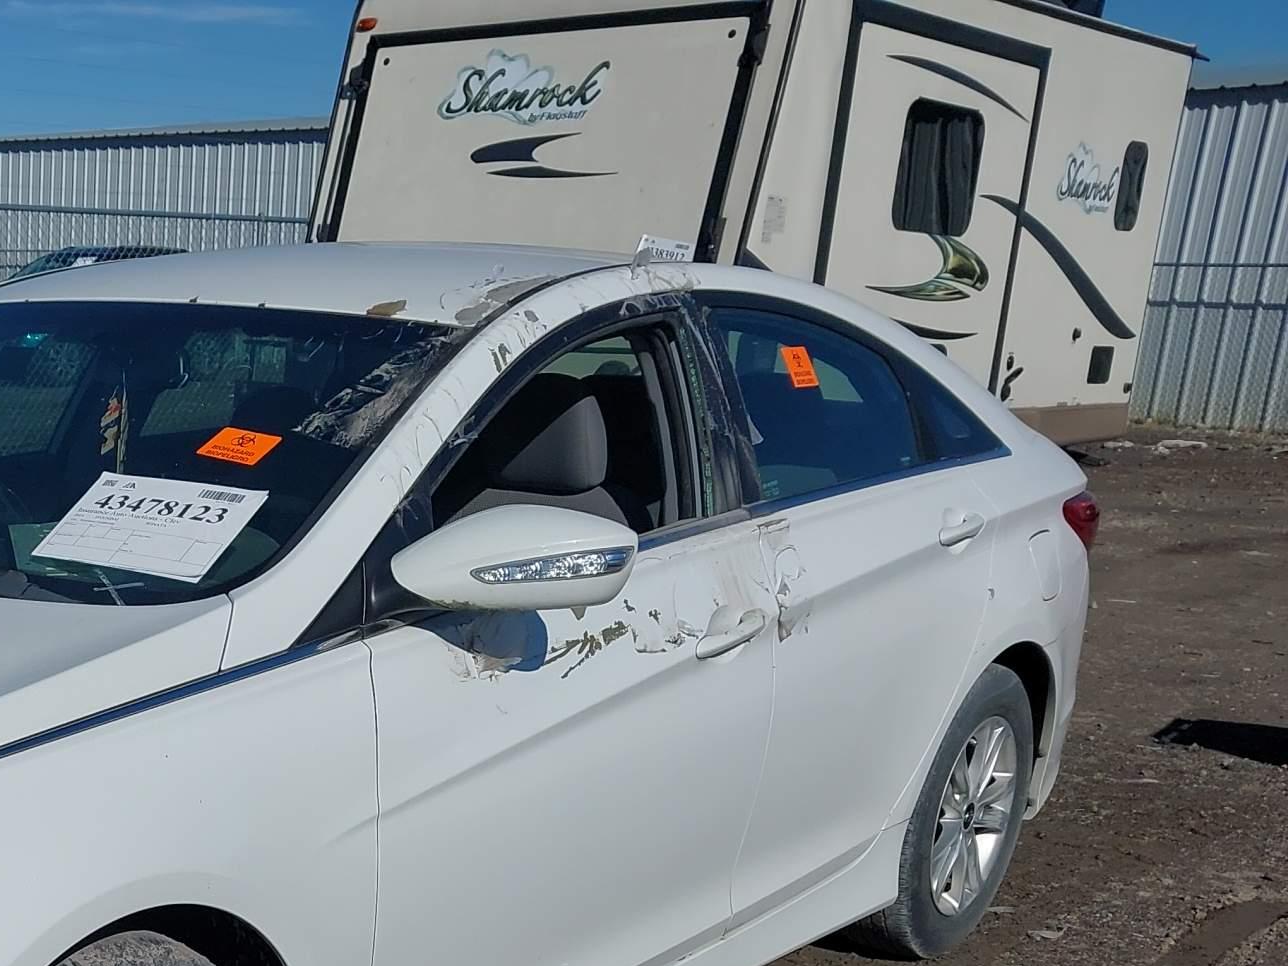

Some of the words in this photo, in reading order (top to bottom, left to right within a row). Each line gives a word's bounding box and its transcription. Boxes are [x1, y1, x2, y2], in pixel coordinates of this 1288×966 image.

[445, 61, 610, 113] Shamrock
[1059, 157, 1119, 202] Shamrock
[94, 493, 229, 524] 43478123
